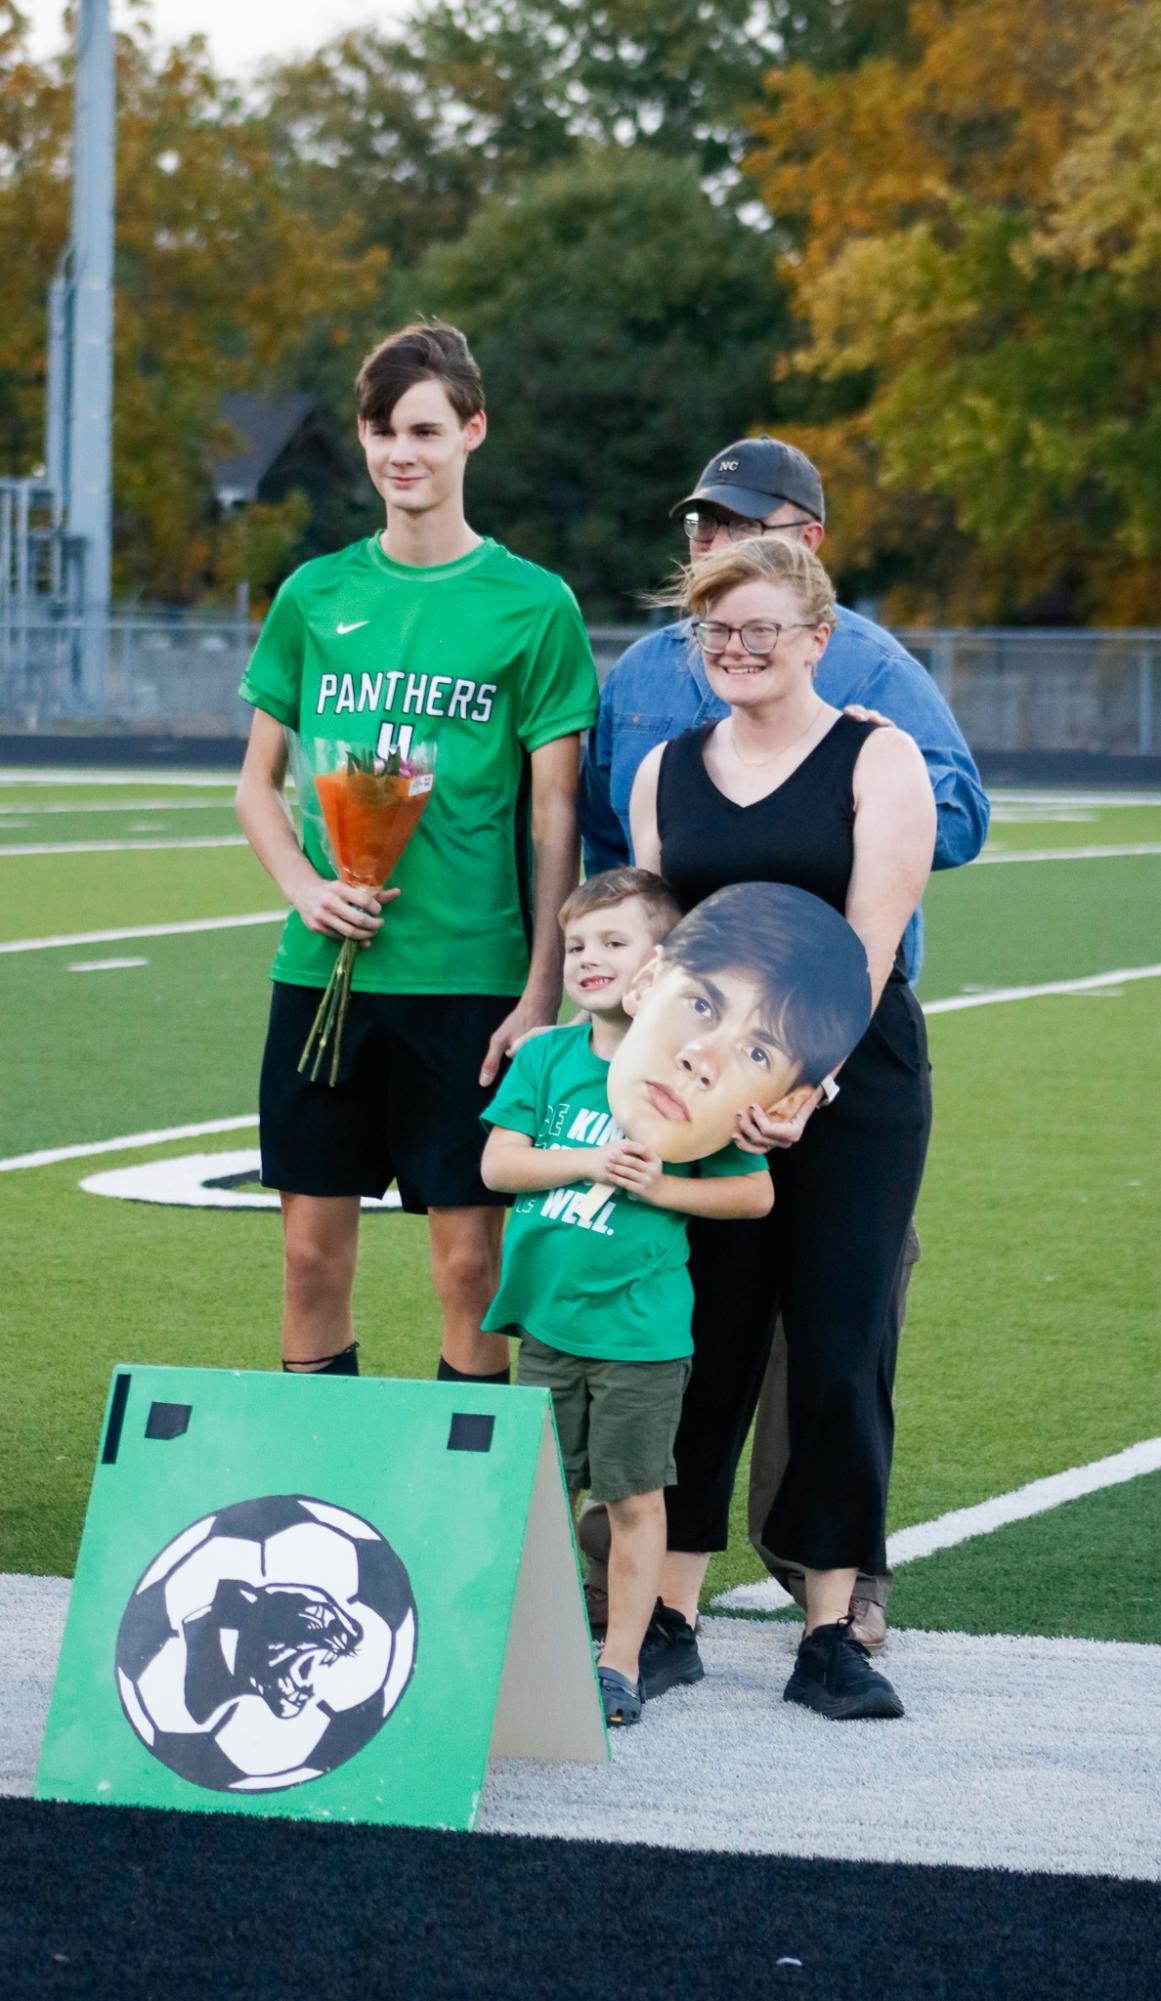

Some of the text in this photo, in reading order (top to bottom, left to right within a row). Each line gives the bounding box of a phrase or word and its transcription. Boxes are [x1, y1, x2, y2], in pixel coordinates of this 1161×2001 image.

[718, 461, 739, 471] NC
[315, 671, 498, 723] PANTHERS
[566, 1108, 625, 1146] KIN
